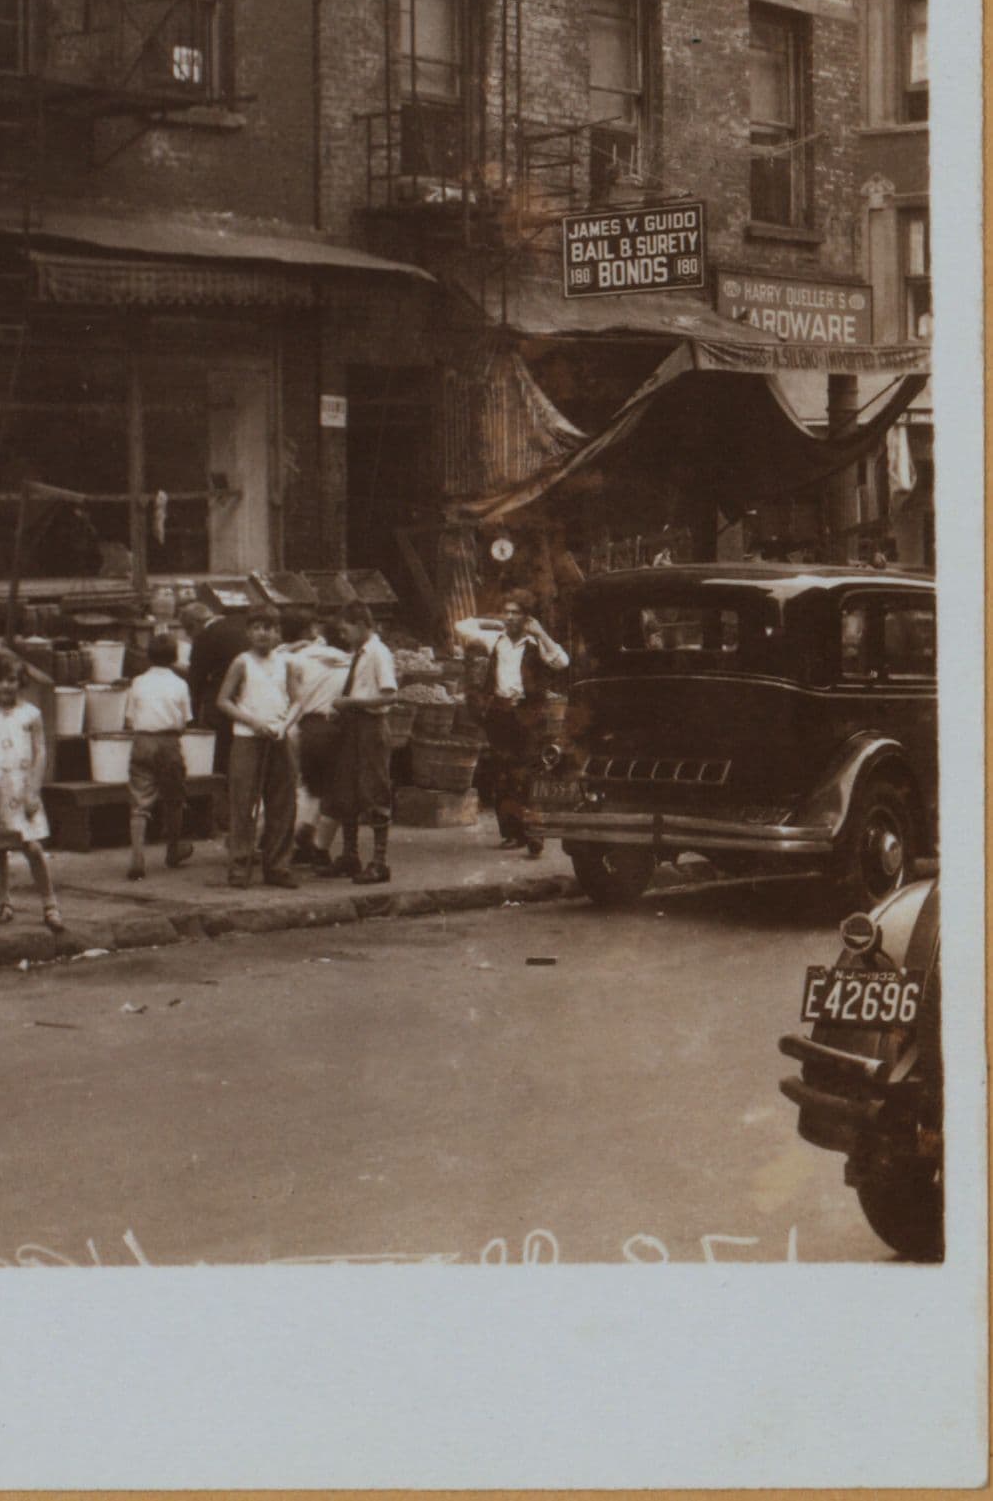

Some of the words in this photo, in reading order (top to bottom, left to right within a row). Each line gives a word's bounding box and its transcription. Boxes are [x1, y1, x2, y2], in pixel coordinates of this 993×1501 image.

[568, 217, 621, 241] JAMES
[625, 216, 641, 235] V.
[644, 210, 698, 233] GUIDO
[571, 239, 615, 263] BAIL
[619, 237, 634, 258] &
[636, 231, 699, 258] SURETY
[597, 258, 669, 289] BONDS
[676, 257, 699, 278] 180
[744, 282, 782, 304] HARRY
[804, 979, 921, 1023] E42696
